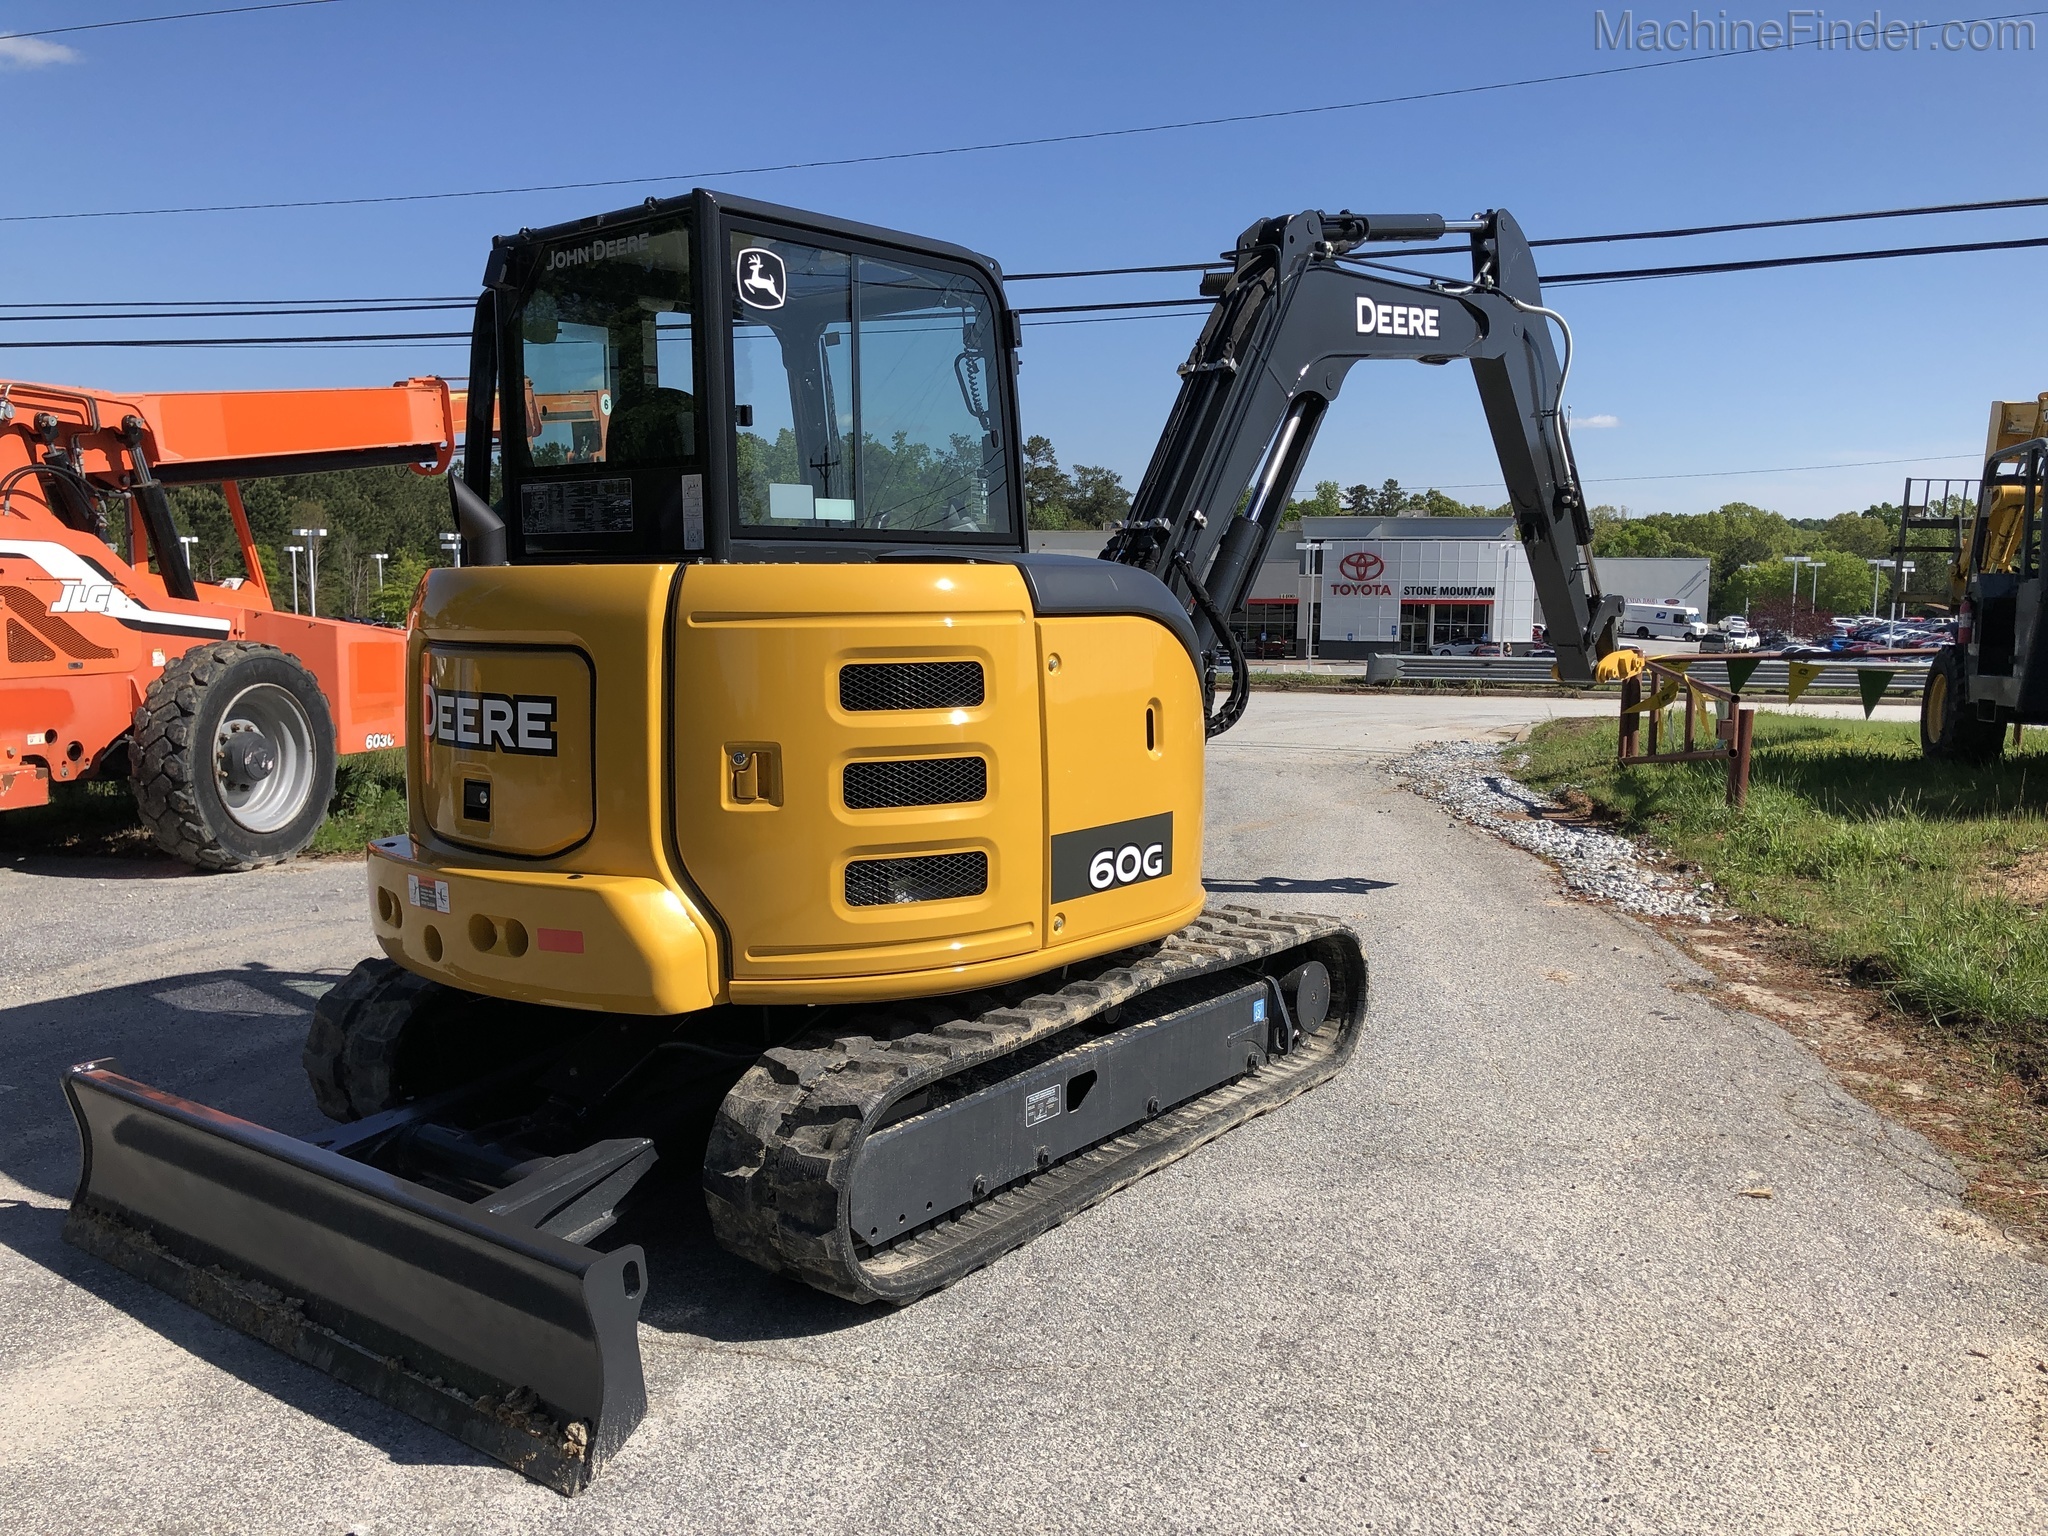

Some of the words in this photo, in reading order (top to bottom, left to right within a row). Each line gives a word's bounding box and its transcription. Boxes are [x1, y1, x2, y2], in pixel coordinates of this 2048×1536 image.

[546, 246, 590, 271] JOHN
[593, 232, 650, 261] DEERE
[1356, 296, 1440, 337] DEERE
[49, 584, 113, 613] JLG
[1331, 584, 1392, 596] TOYOTA
[1403, 586, 1437, 596] STONE
[1439, 586, 1495, 596] MOUNTAIN
[423, 683, 553, 750] DEERE
[1088, 843, 1163, 891] 60G
